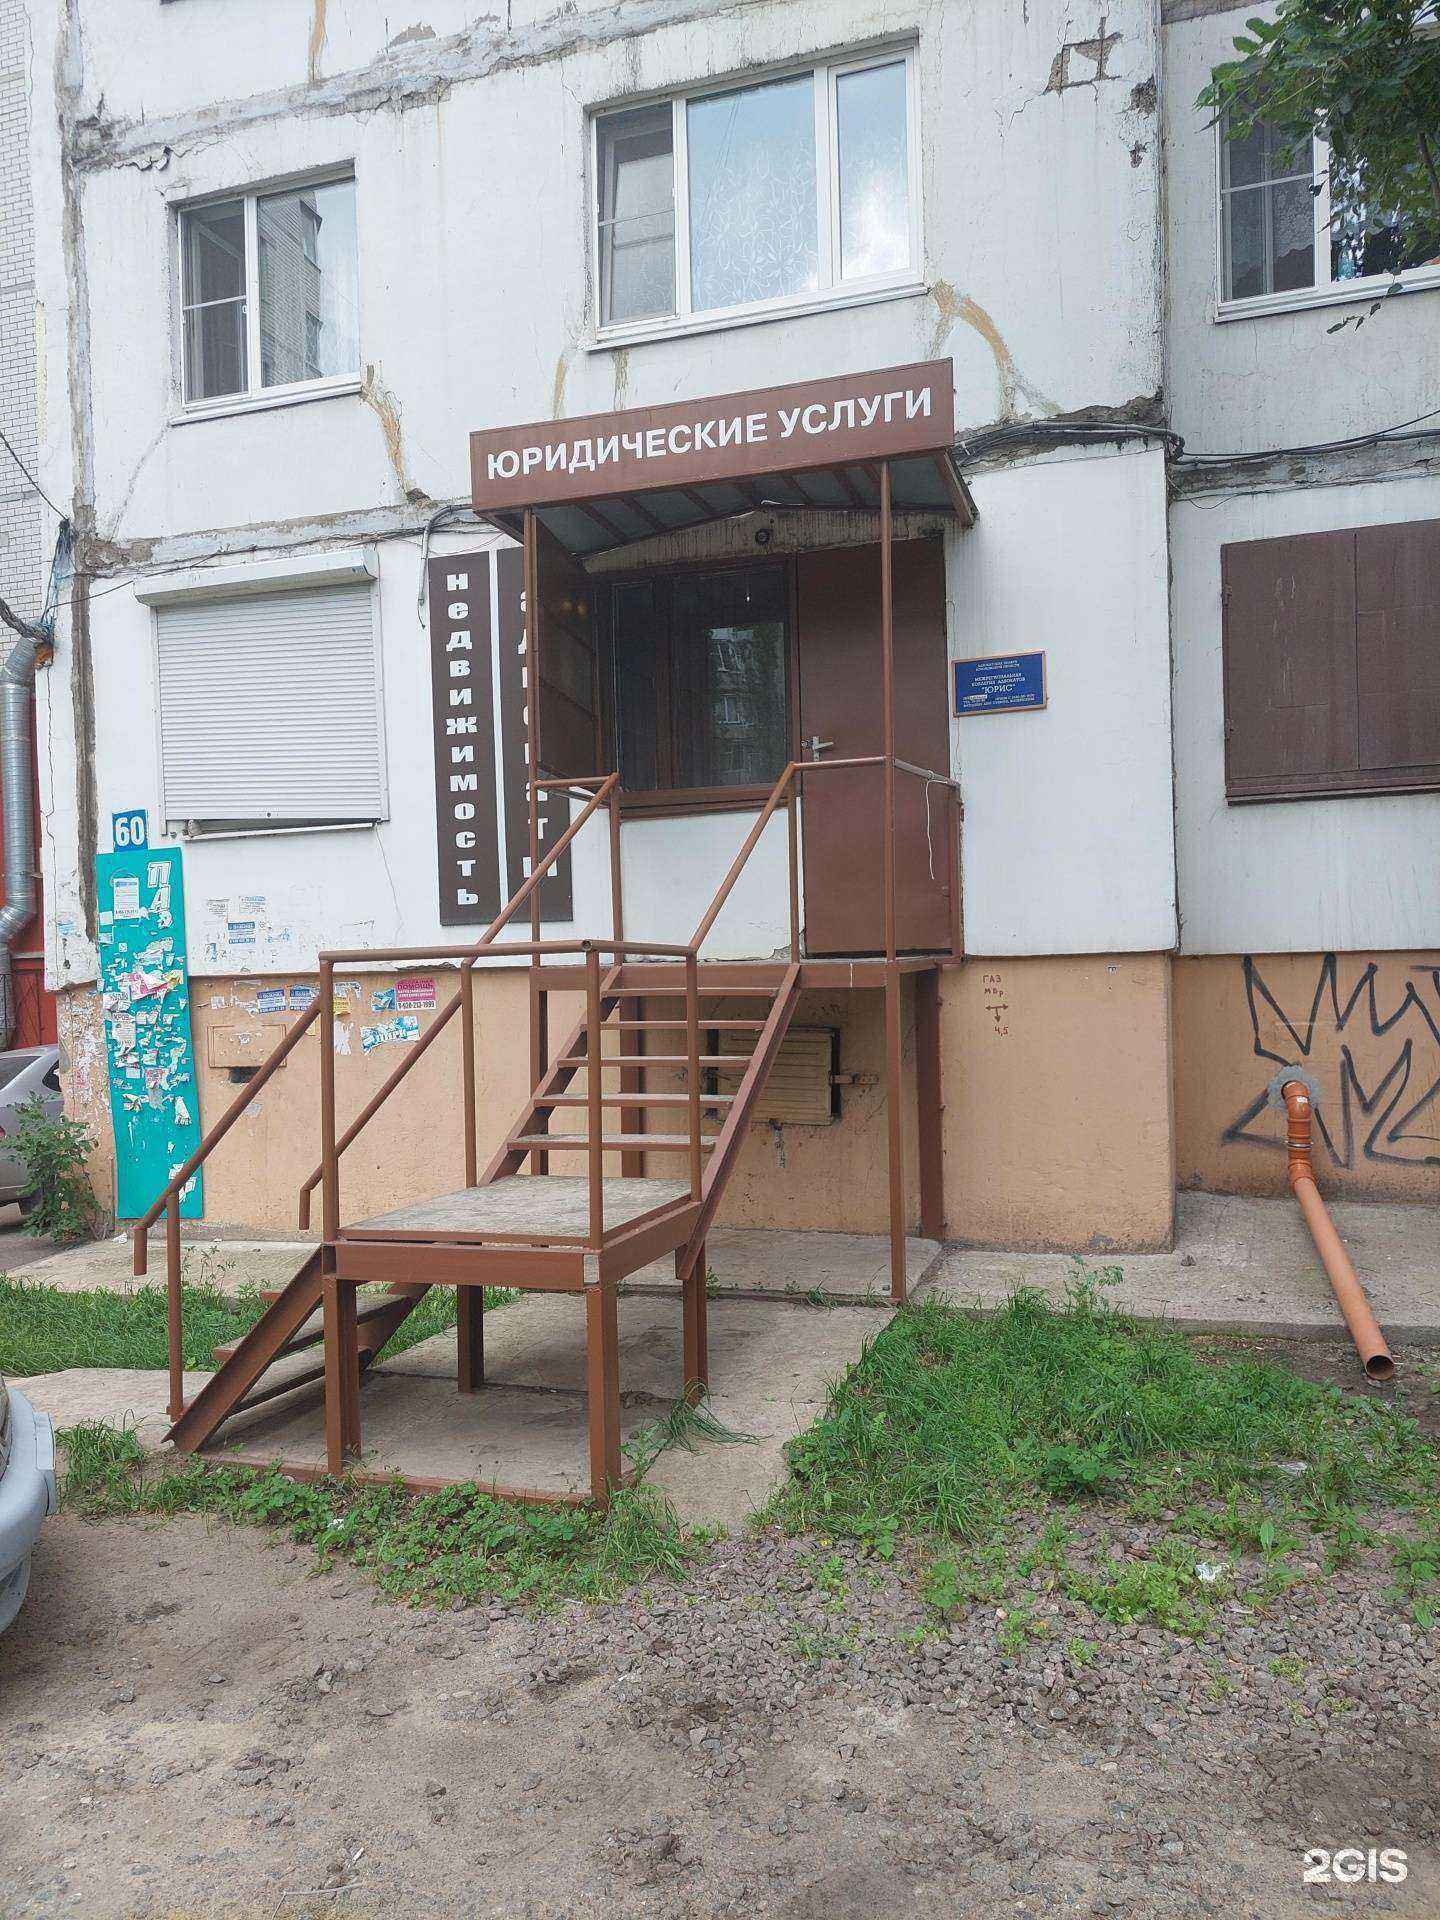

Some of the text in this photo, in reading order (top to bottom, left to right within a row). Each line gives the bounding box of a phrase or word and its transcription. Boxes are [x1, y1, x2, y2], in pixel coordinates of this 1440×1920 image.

[487, 387, 932, 480] ЮРИДИЧЕСКИЕ УСЛУГИ
[981, 683, 1016, 694] "ЮРИС"
[114, 816, 146, 847] 60
[982, 974, 1002, 984] ГАЗ
